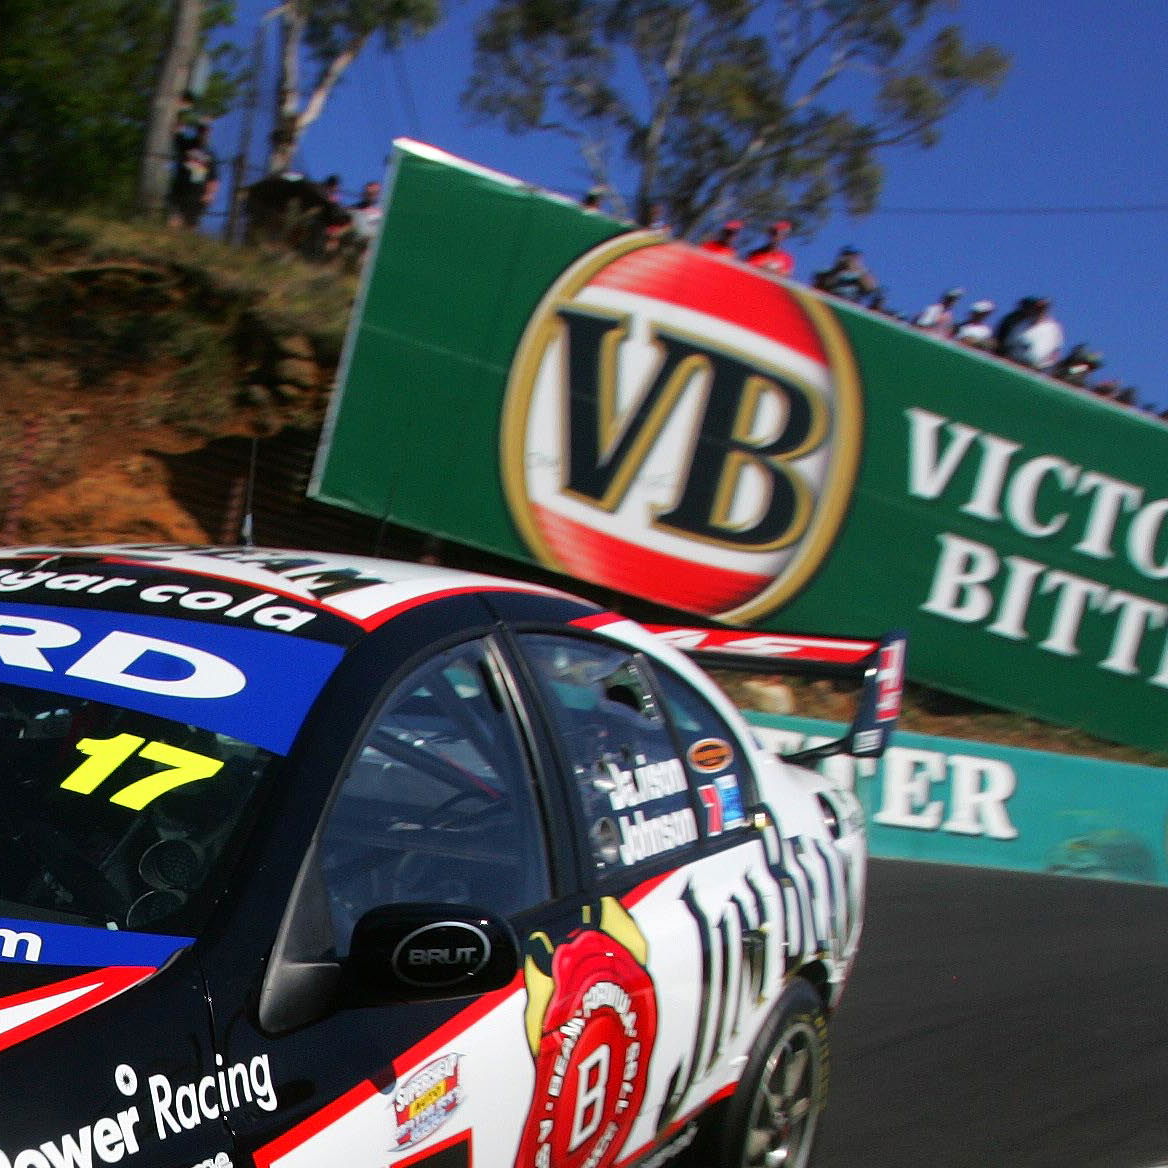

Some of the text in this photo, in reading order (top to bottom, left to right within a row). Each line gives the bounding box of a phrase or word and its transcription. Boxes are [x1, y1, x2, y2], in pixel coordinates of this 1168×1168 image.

[554, 305, 832, 552] VB
[139, 584, 317, 632] cola
[919, 532, 1168, 689] BITT
[59, 733, 224, 811] 17
[148, 1053, 277, 1140] Racing
